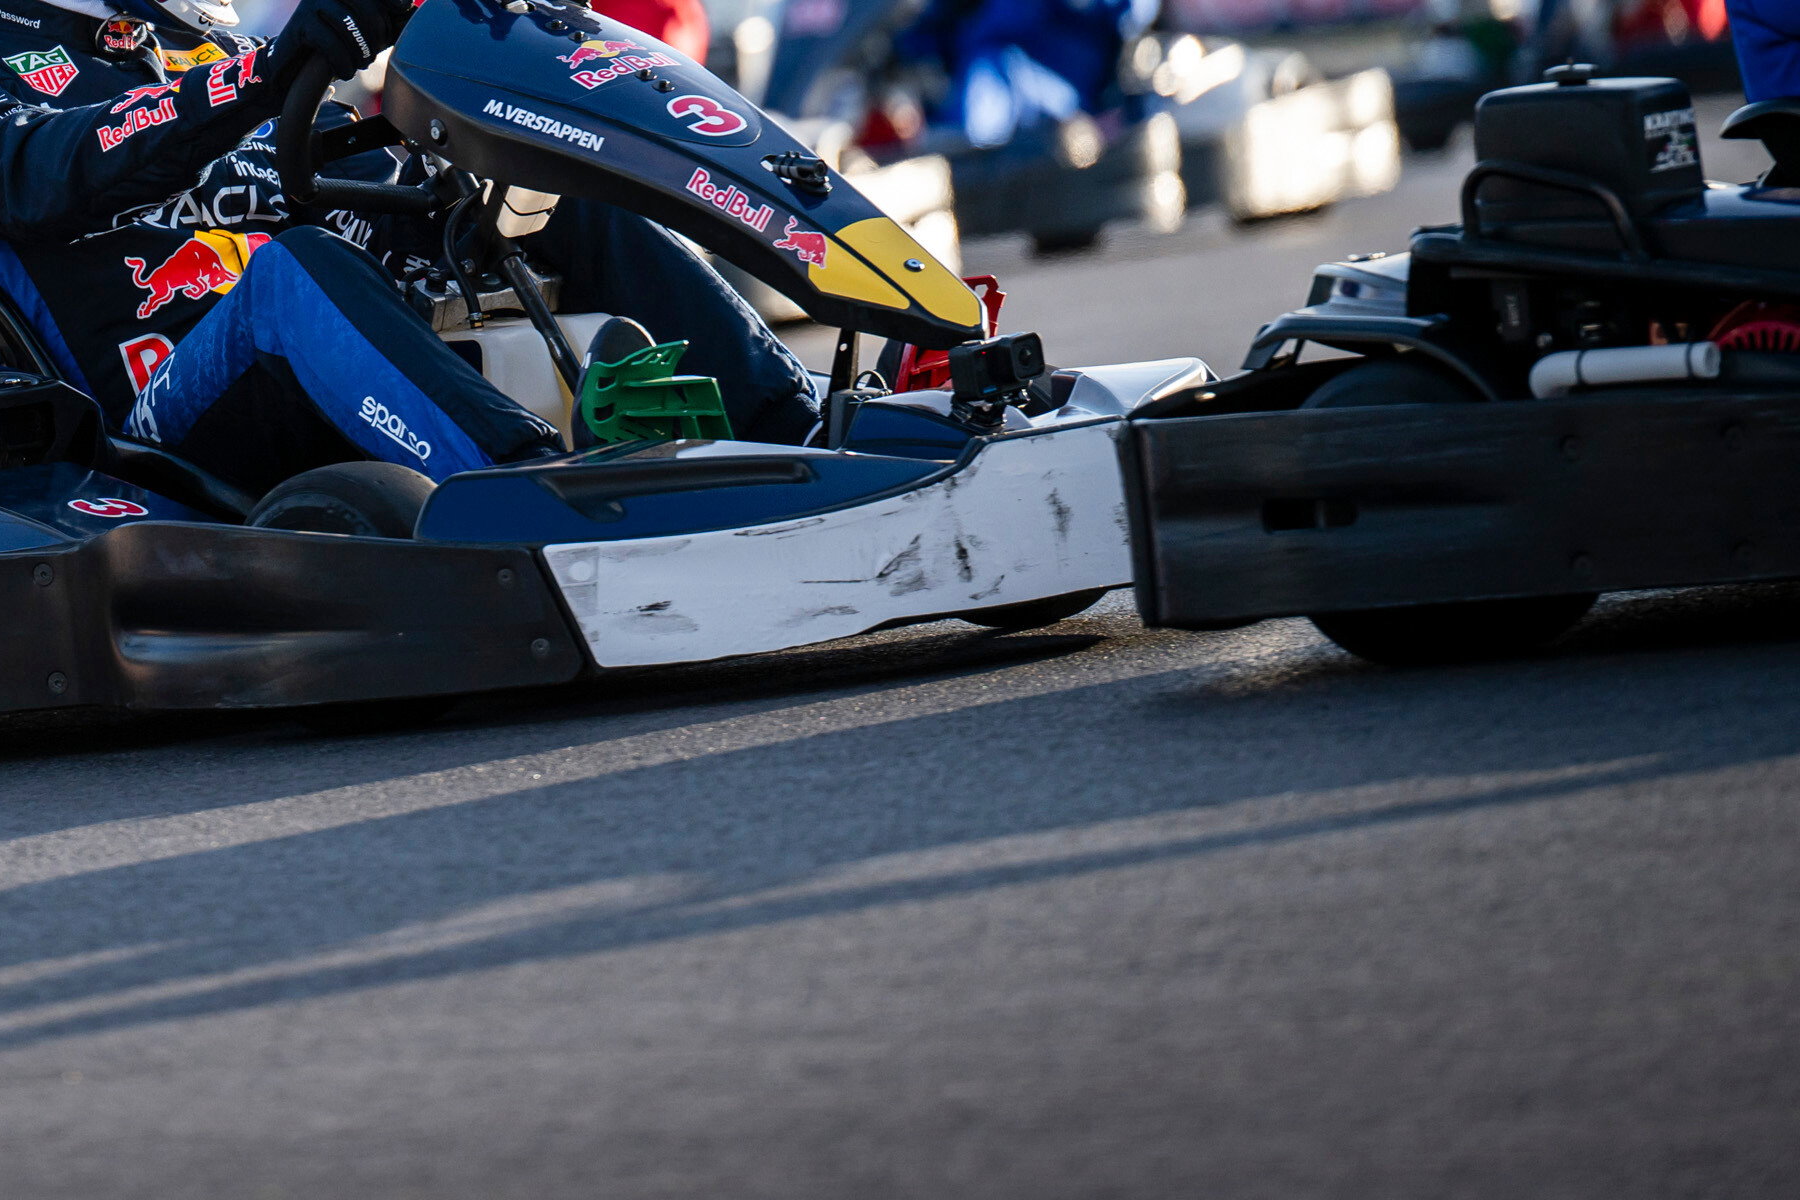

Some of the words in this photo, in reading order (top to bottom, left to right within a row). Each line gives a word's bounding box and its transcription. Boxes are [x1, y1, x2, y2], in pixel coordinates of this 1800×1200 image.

[9, 47, 64, 71] TAG
[667, 95, 748, 136] 3
[359, 396, 431, 463] sparco
